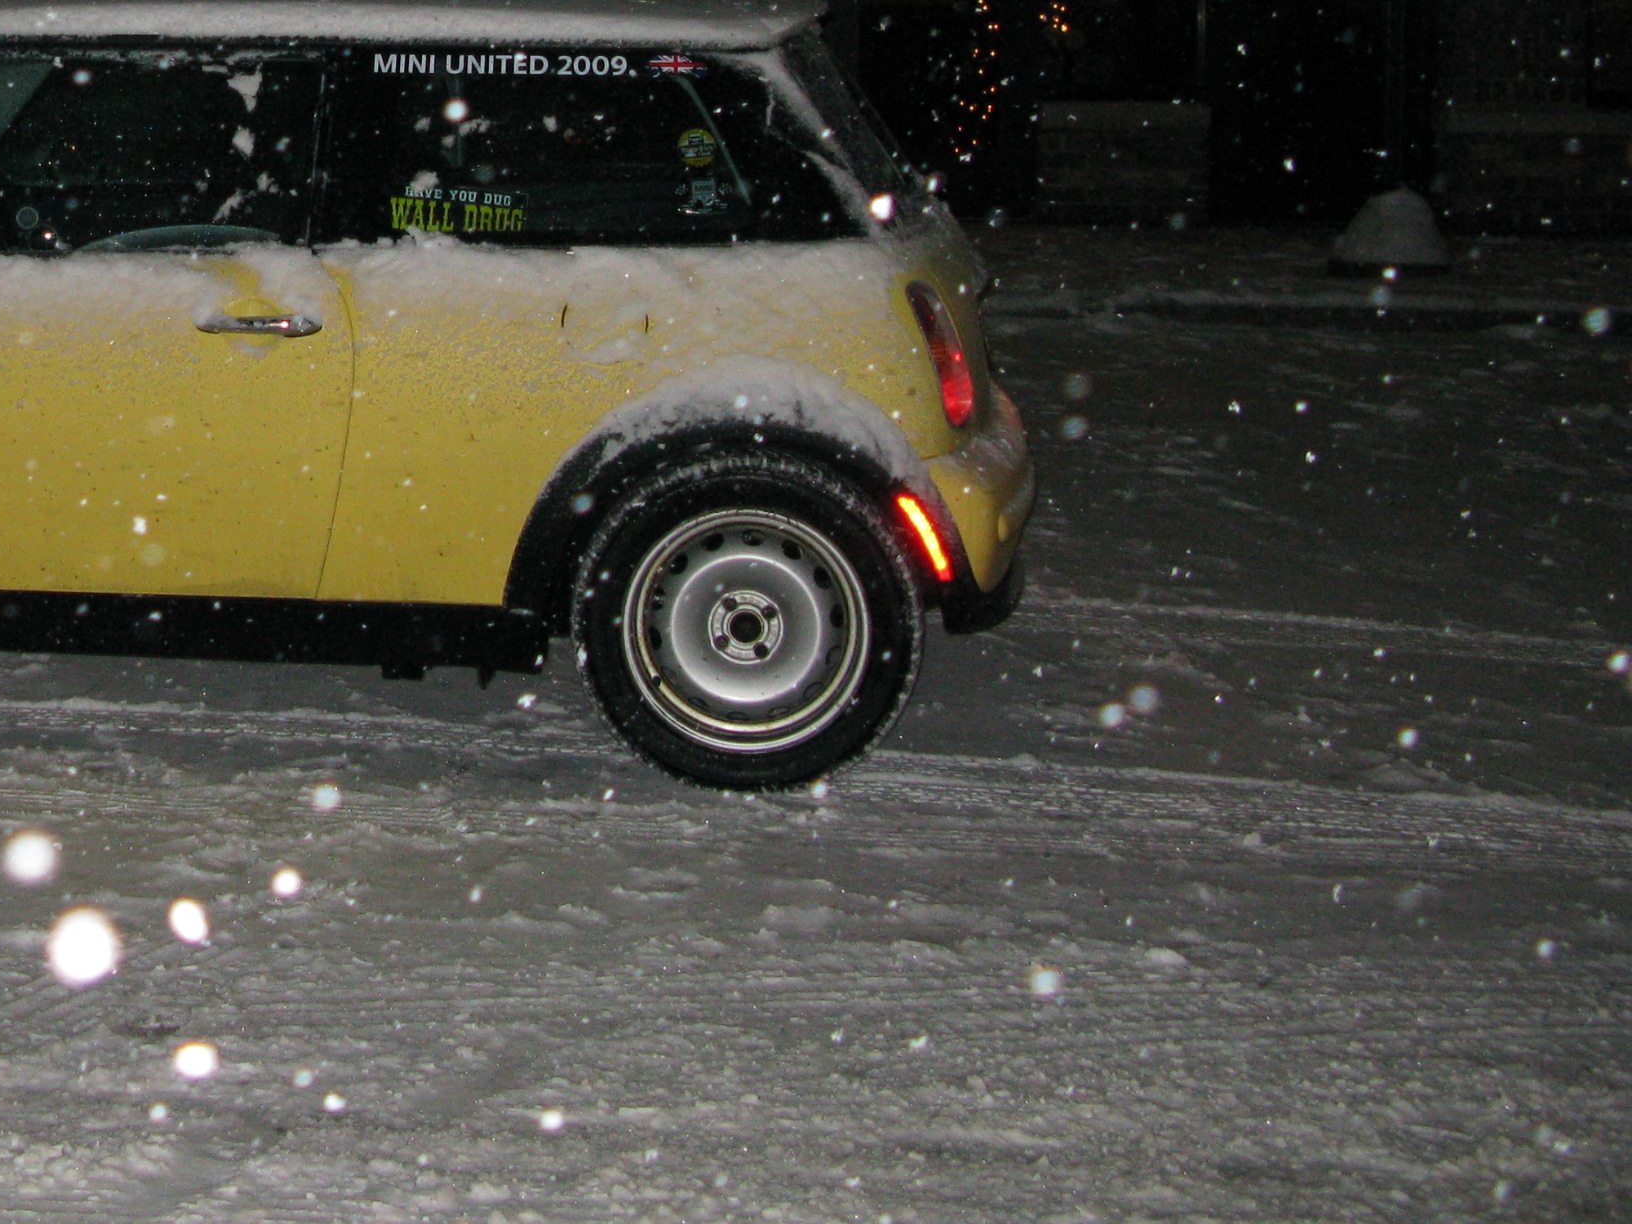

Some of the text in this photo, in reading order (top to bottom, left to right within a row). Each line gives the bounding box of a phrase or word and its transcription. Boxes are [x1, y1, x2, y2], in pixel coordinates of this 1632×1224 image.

[373, 53, 436, 74] MINI
[445, 54, 549, 75] UNITED
[449, 189, 477, 203] YOU
[483, 193, 512, 206] DUG
[390, 197, 523, 231] WALL DRUG
